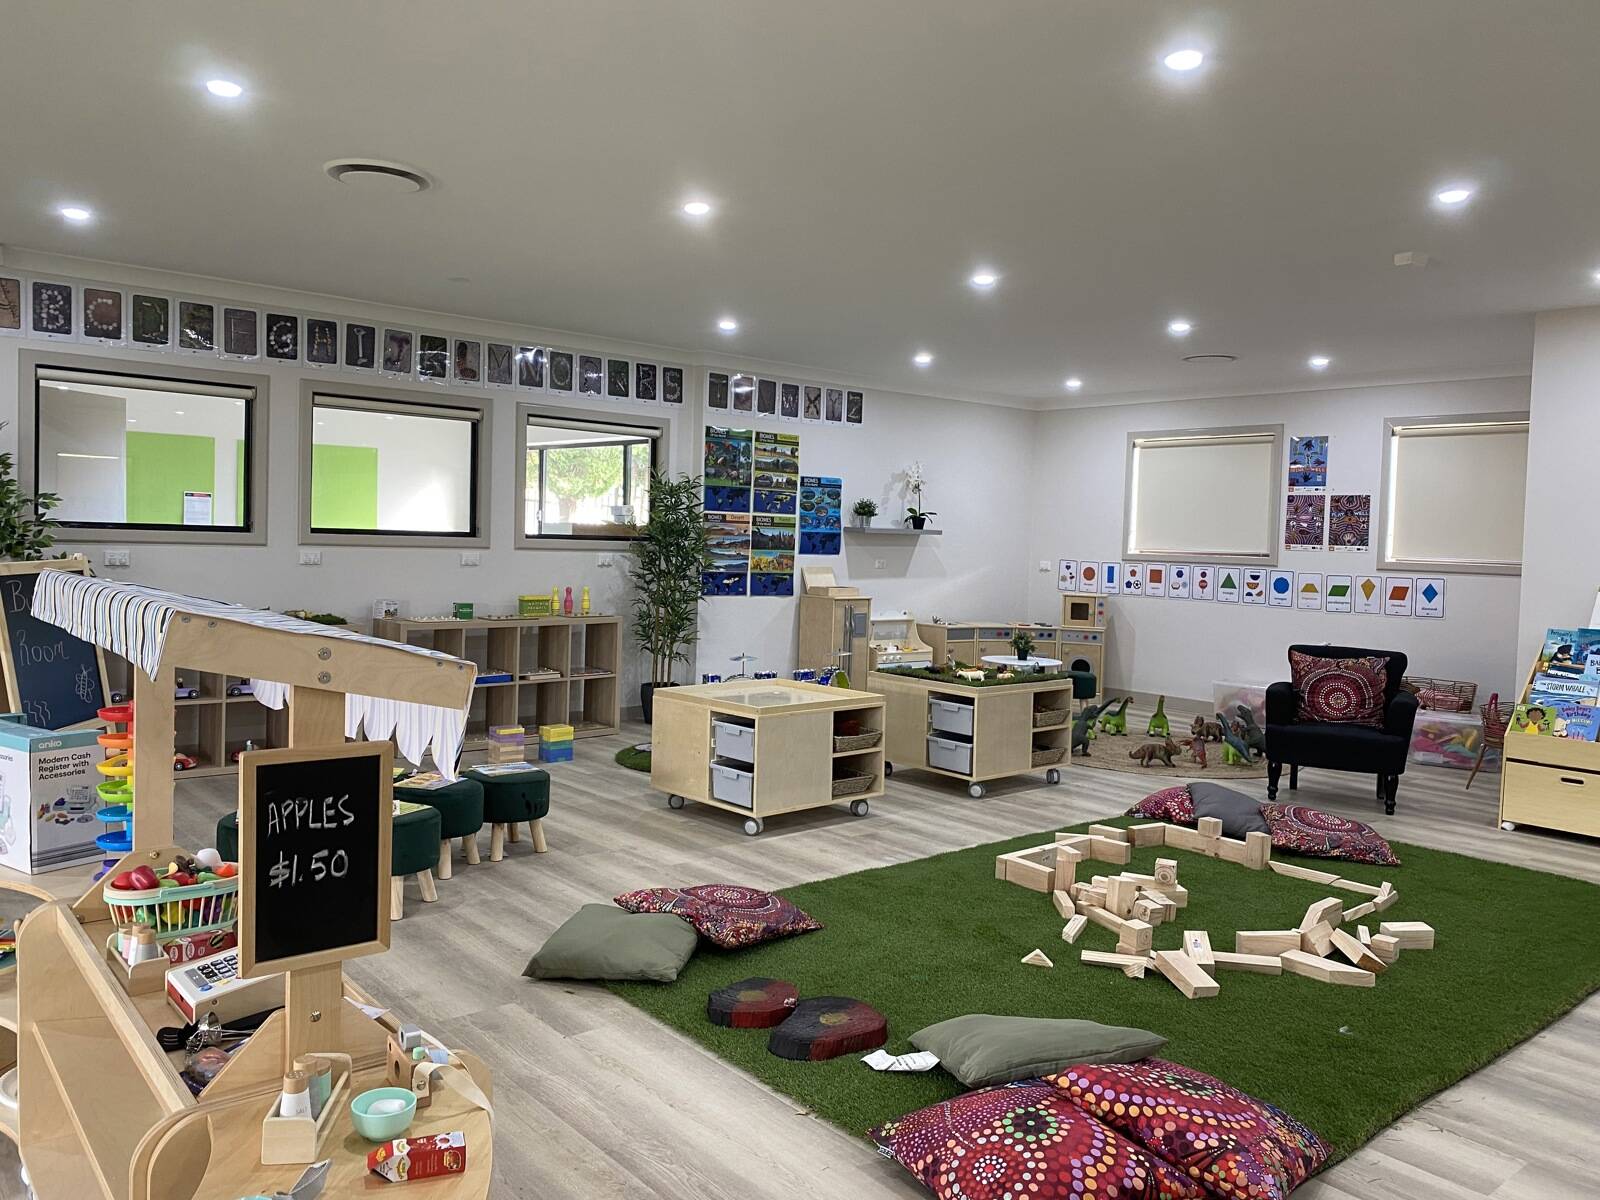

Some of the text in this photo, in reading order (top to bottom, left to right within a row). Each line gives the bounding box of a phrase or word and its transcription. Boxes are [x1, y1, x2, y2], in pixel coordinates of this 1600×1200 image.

[41, 288, 64, 329] B
[86, 298, 117, 330] C
[269, 321, 293, 353] G
[313, 326, 332, 355] H
[457, 342, 477, 379] L
[806, 391, 821, 416] X
[16, 630, 69, 666] Room
[38, 739, 63, 749] anko
[38, 752, 91, 765] Modern Cash
[38, 760, 90, 773] Register with
[38, 769, 86, 780] Accessories
[267, 794, 355, 837] APPLES
[269, 849, 349, 888] $1.50
